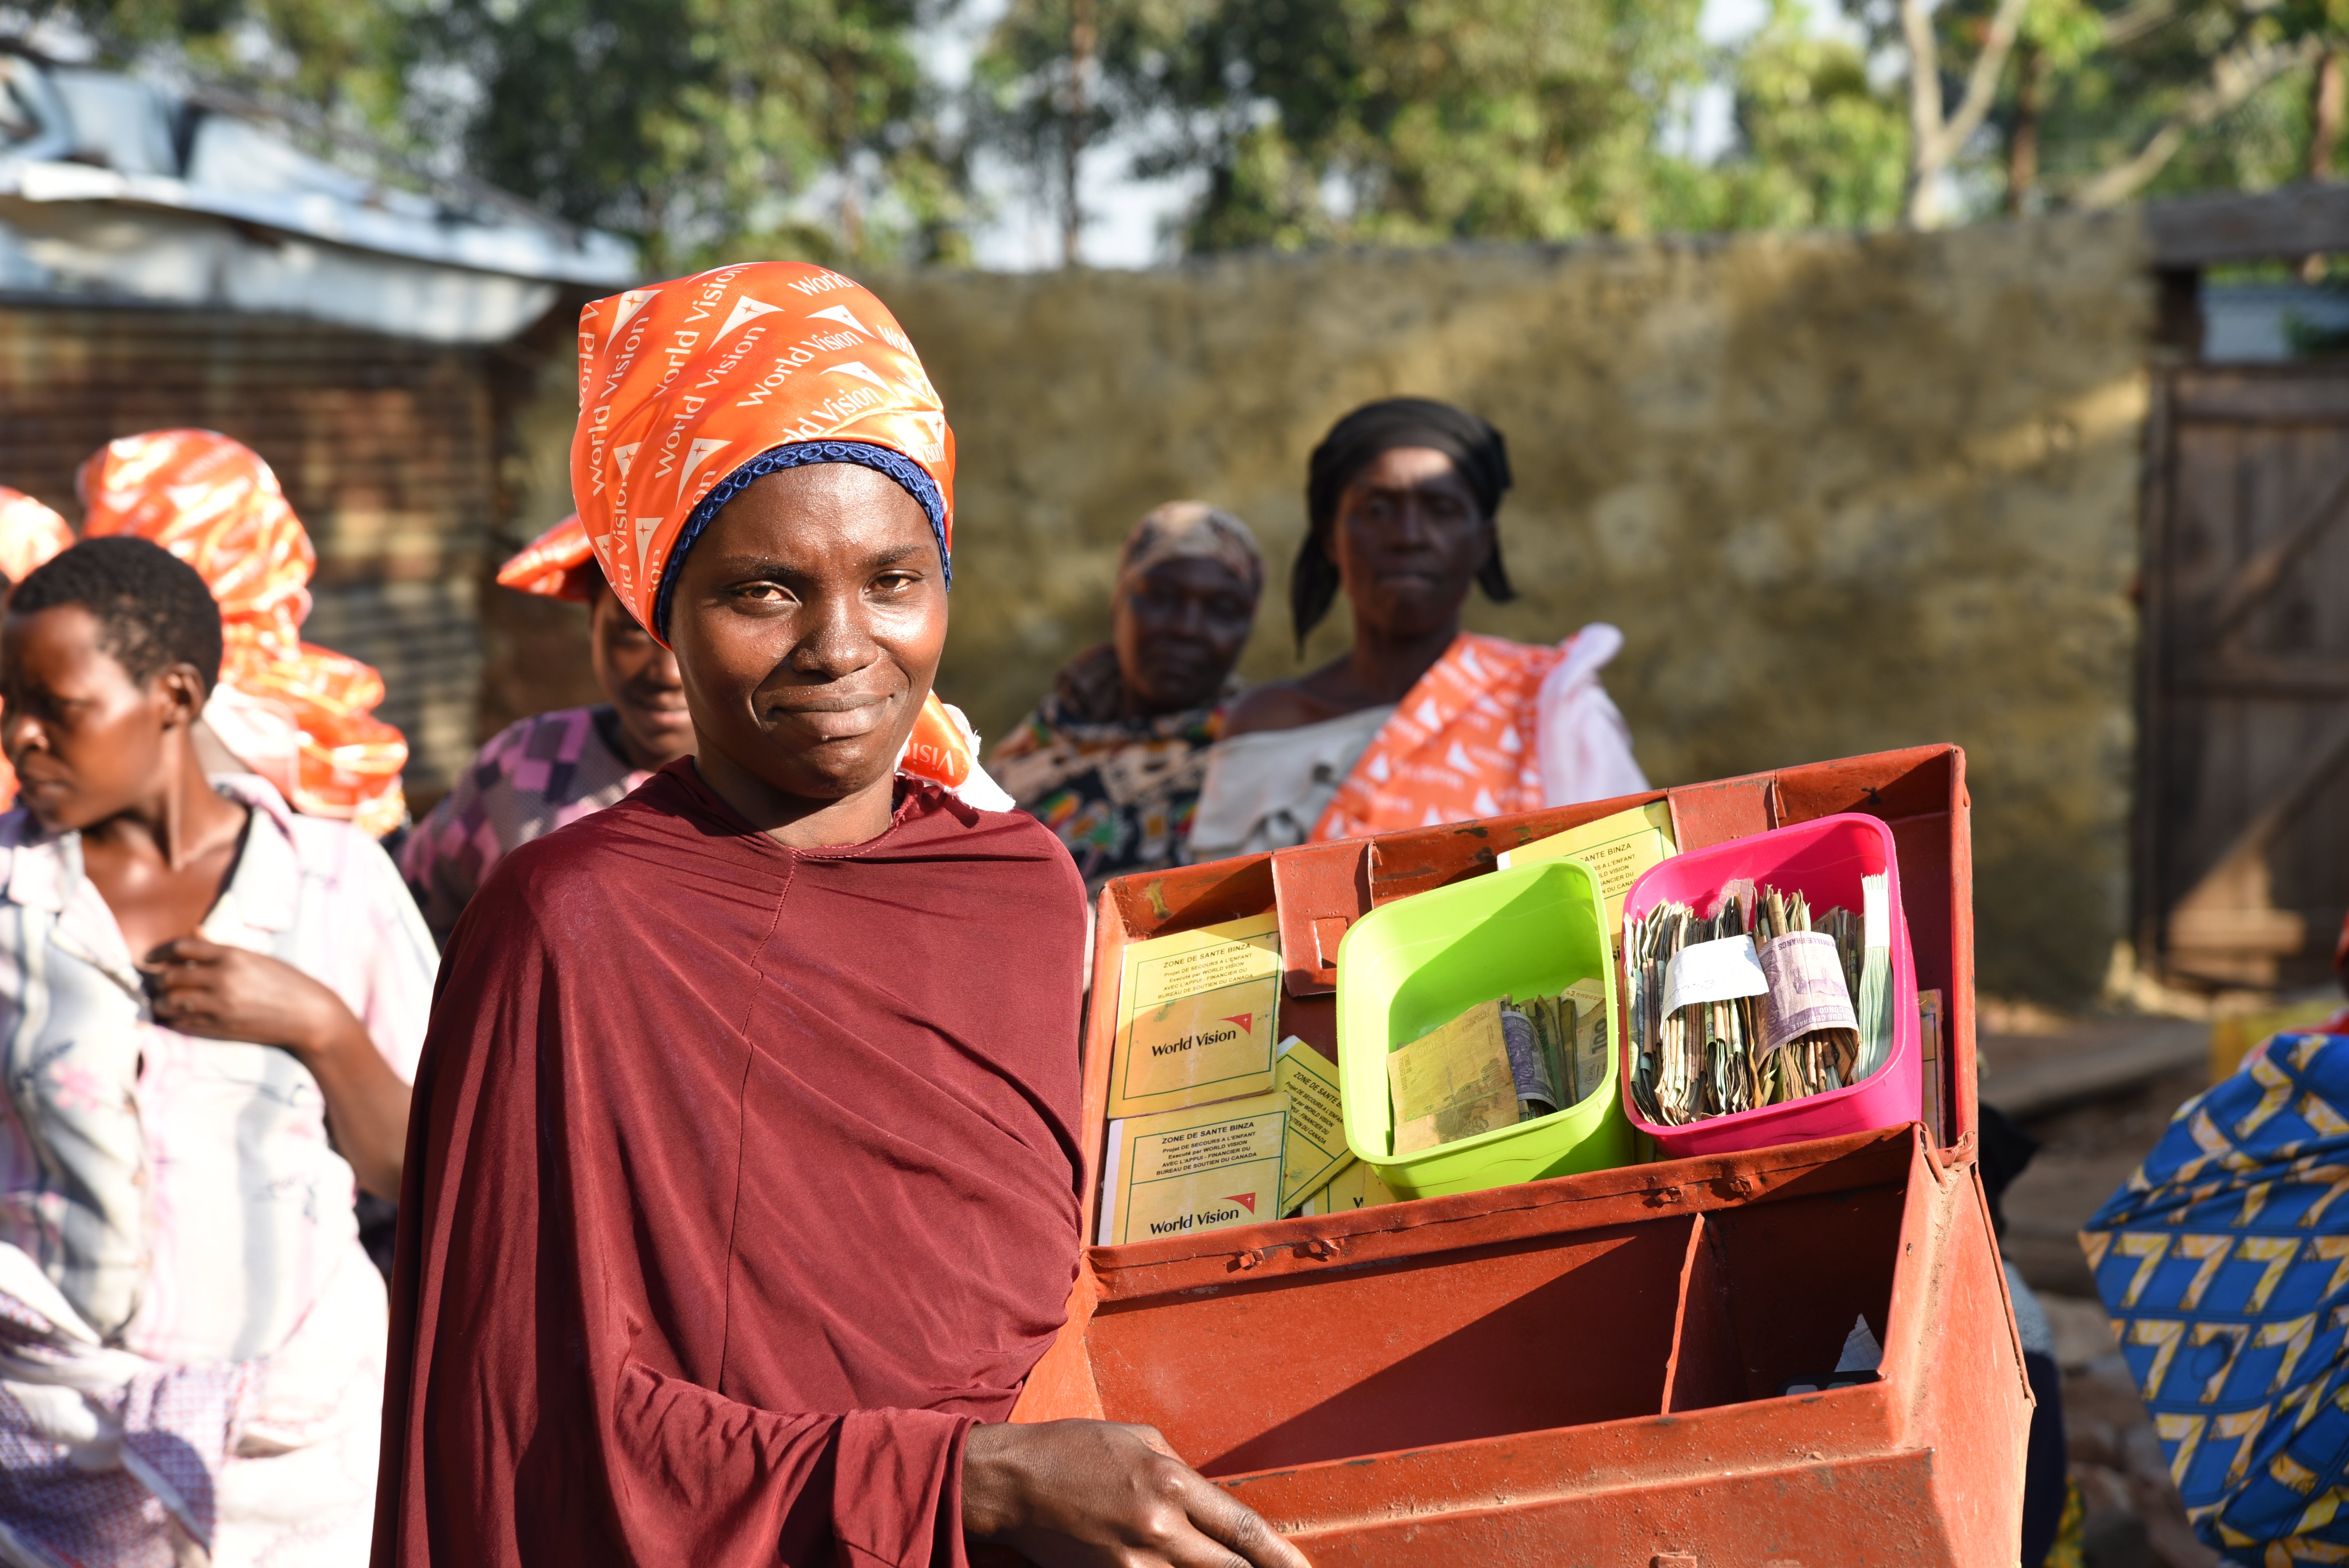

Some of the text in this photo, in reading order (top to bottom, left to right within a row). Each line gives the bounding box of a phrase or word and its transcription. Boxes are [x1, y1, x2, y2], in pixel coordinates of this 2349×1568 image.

[787, 270, 854, 296] World
[684, 267, 749, 323] Vision
[736, 330, 864, 407] World Vision
[588, 317, 650, 497] World Vision
[655, 396, 707, 478] World
[695, 327, 767, 389] Vision
[811, 386, 882, 422] Vision
[1608, 843, 1631, 855] BINZA
[1608, 854, 1635, 866] L'ENFANT
[1609, 865, 1629, 874] VISION
[1778, 938, 1805, 950] FRANCS
[1164, 958, 1185, 968] ZONE
[1199, 948, 1225, 959] SANTE
[1228, 943, 1251, 953] BINZA
[1191, 961, 1218, 971] SECOURS
[1225, 953, 1252, 963] L'ENFANT
[1180, 978, 1202, 987] L'APPUI
[1207, 970, 1237, 980] FINANCIER
[1203, 966, 1223, 975] WORLD
[1158, 991, 1182, 999] BUREAU
[1193, 982, 1217, 991] SOUTIEN
[1791, 1015, 1825, 1031] CENTRALE
[1152, 1030, 1236, 1057] World Vision
[1285, 1082, 1298, 1090] Projet
[1303, 1093, 1323, 1110] SECOURS
[1294, 1072, 1338, 1104] ZONE DE SANTE
[1300, 1113, 1323, 1130] FINANCIER
[1321, 1126, 1330, 1135] DU
[1304, 1105, 1320, 1117] WORLD
[1319, 1115, 1335, 1127] VISION
[1162, 1135, 1185, 1144] ZONE
[1201, 1127, 1228, 1137] SANTE
[1230, 1122, 1254, 1131] BINZA
[1191, 1139, 1220, 1147] SECOURS
[1227, 1131, 1256, 1141] L'ENFANT
[1308, 1130, 1326, 1144] CANADA
[1180, 1156, 1203, 1164] L'APPUI
[1208, 1148, 1240, 1158] FINANCIER
[1203, 1144, 1225, 1152] WORLD
[1194, 1159, 1219, 1168] SOUTIEN
[1231, 1152, 1256, 1160] CANADA
[1150, 1209, 1239, 1235] World Vision
